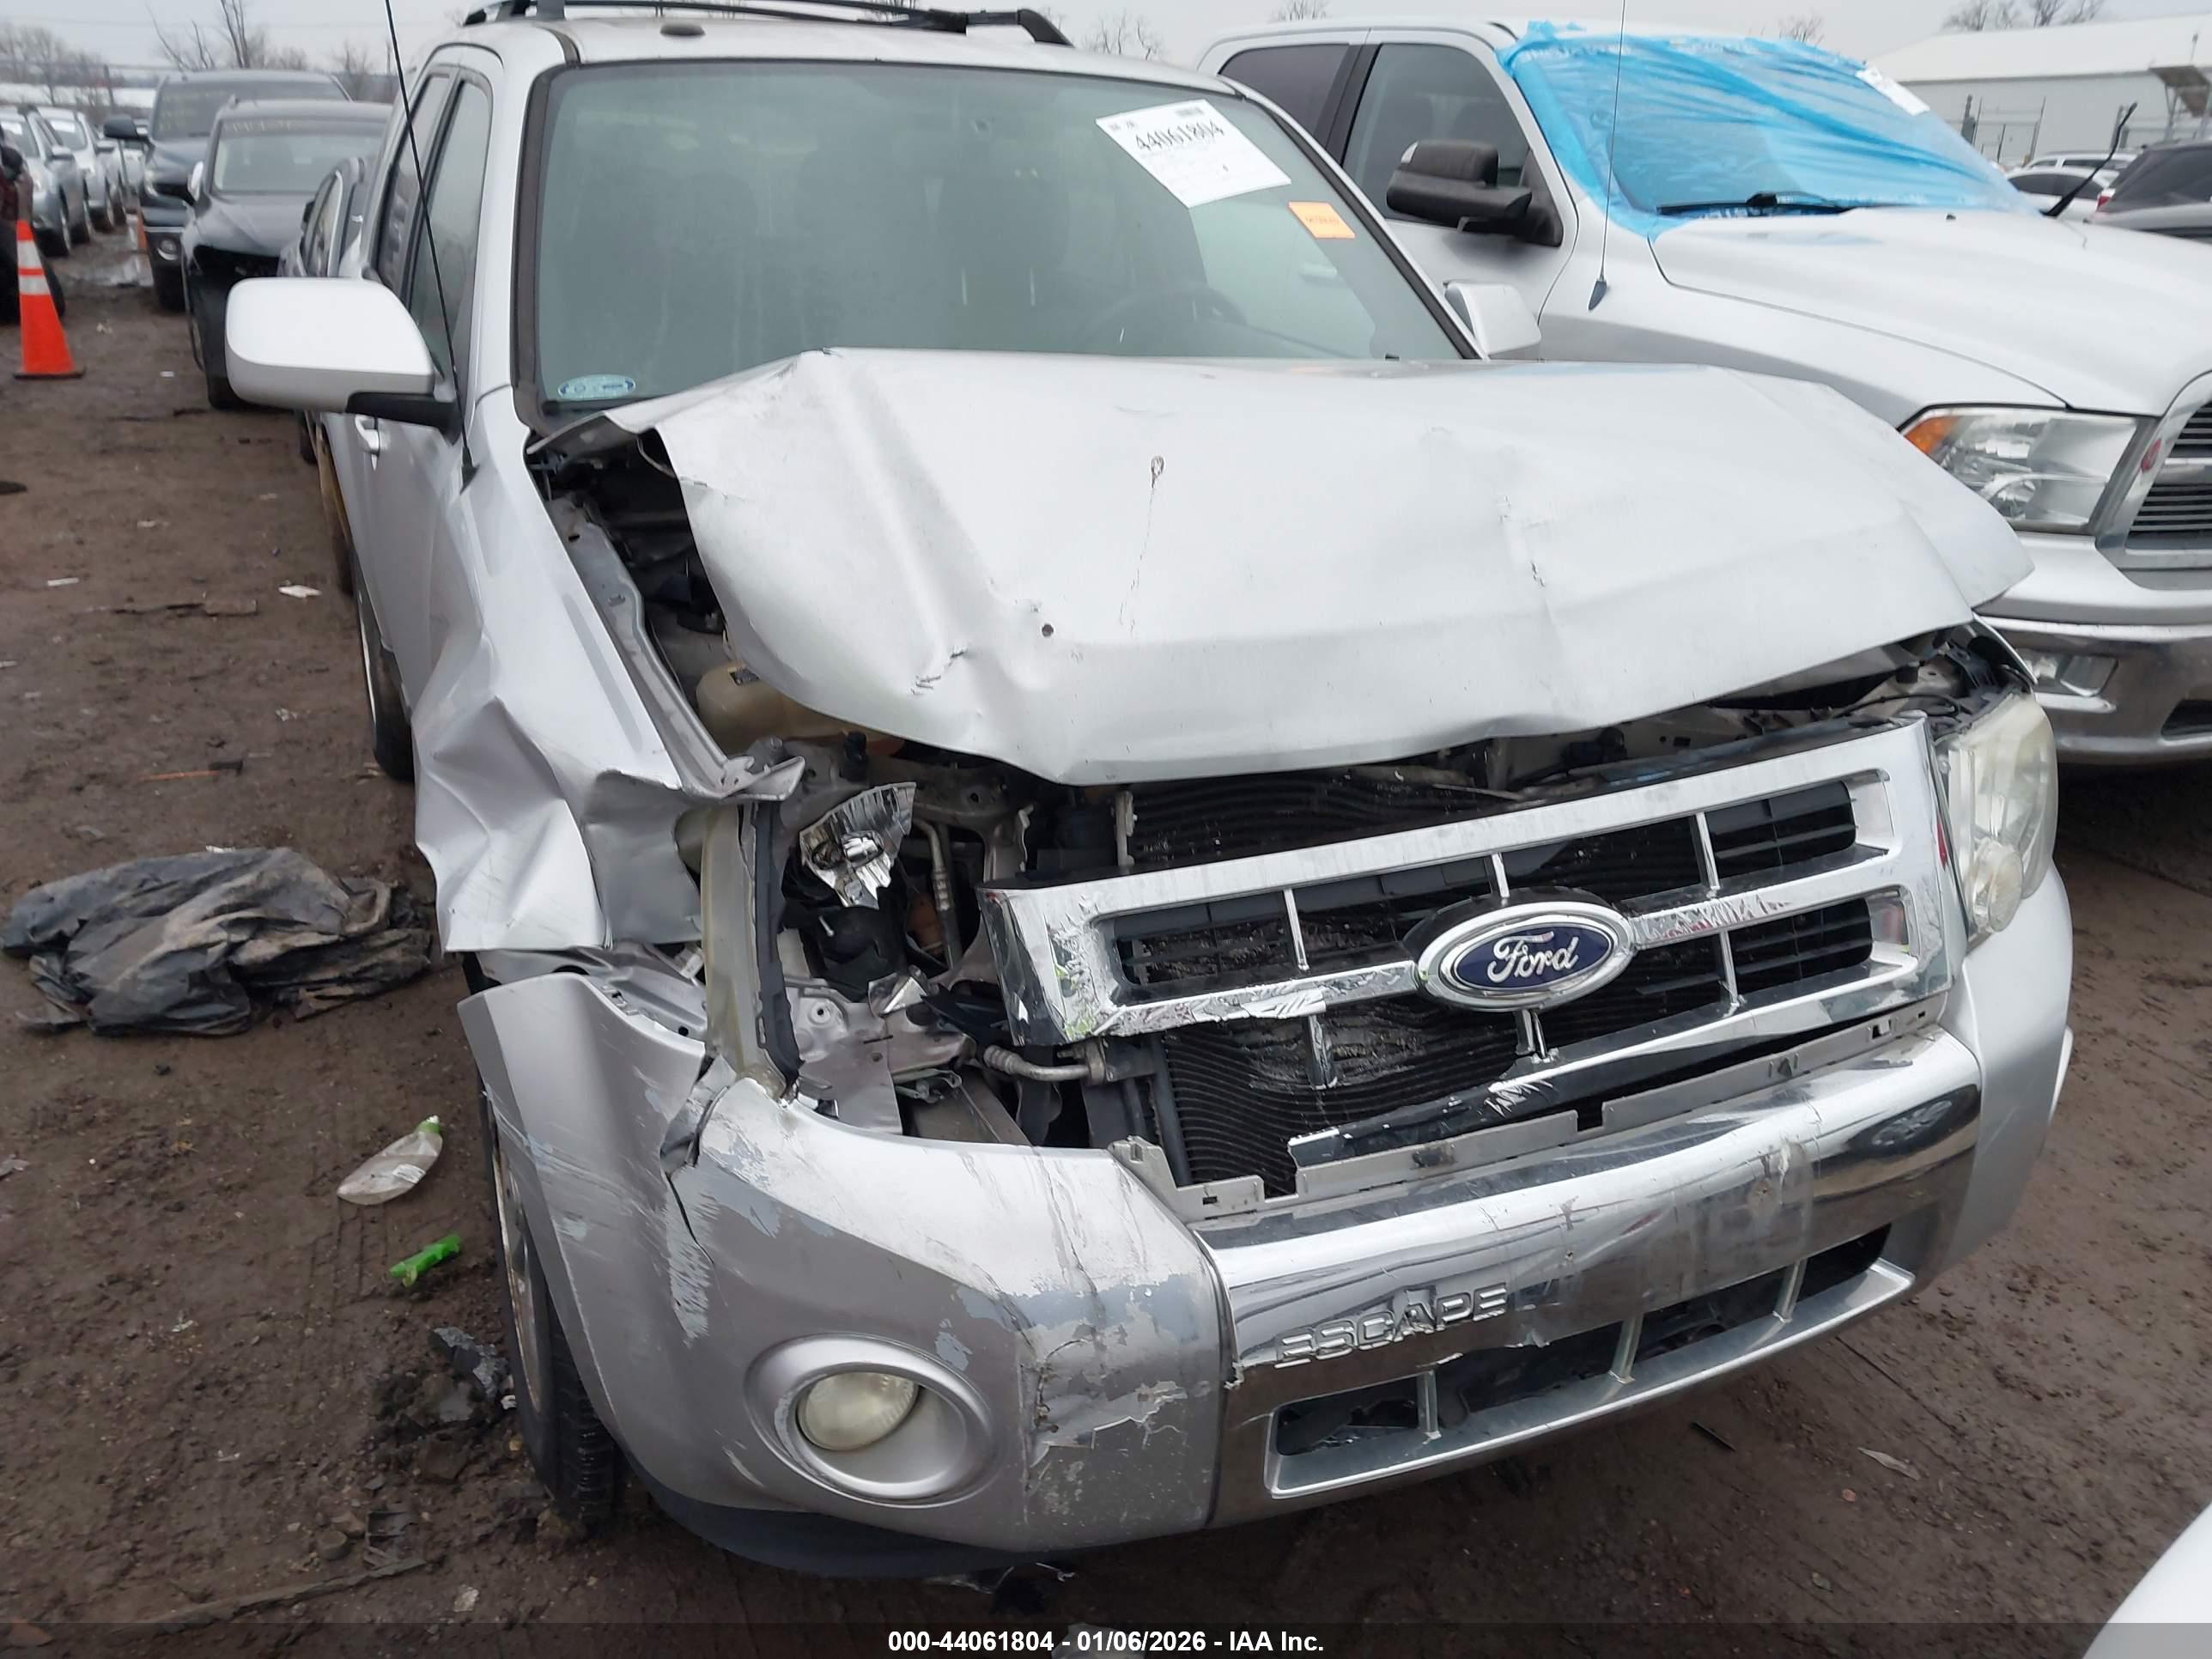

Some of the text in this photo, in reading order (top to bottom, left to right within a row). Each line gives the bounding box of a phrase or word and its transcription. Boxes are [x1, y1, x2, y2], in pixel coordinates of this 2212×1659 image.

[1135, 119, 1225, 151] 44061804
[1486, 931, 1579, 982] Ford
[1274, 1285, 1507, 1368] ESCAPE
